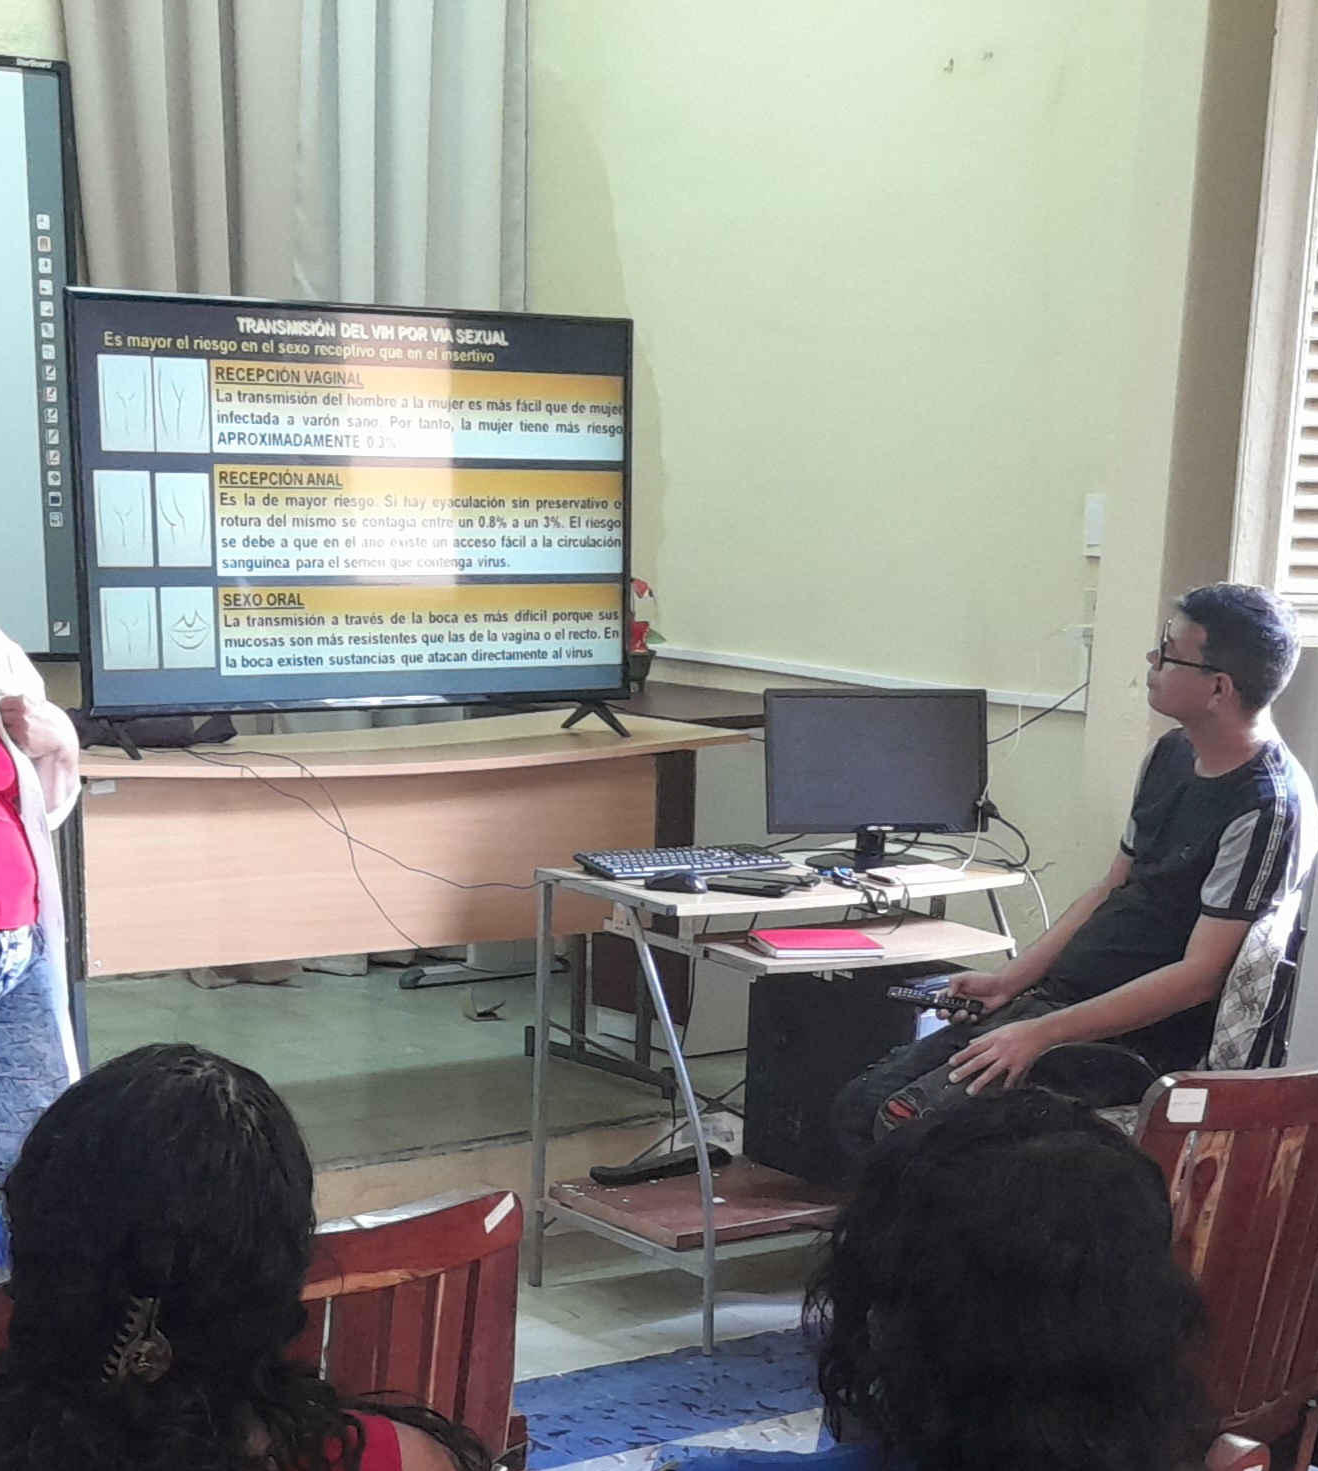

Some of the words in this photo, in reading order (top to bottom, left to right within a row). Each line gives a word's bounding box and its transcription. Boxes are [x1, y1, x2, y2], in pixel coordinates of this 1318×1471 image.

[236, 316, 336, 335] TRANSMISIÓN
[340, 322, 369, 340] DEL
[370, 324, 394, 340] VIH
[397, 325, 428, 342] POR
[456, 328, 509, 346] SEXUAL
[104, 330, 122, 347] Es
[126, 335, 172, 352] mayor
[176, 334, 189, 349] el
[193, 335, 237, 355] riesgo
[240, 340, 258, 353] en
[261, 338, 274, 353] el
[278, 342, 310, 355] sexo
[214, 366, 300, 384] RECEPCIÓN
[304, 370, 363, 387] VAGINAL
[215, 388, 232, 403] La
[236, 392, 317, 405] transmisión
[322, 392, 342, 406] del
[428, 399, 464, 414] mujer
[468, 399, 482, 411] es
[486, 398, 512, 412] más
[516, 398, 541, 413] fácil
[544, 403, 567, 416] que
[571, 401, 586, 414] de
[589, 405, 624, 419] mujer
[215, 410, 279, 425] infectada
[302, 415, 339, 427] varón
[460, 417, 471, 431] la
[478, 421, 512, 436] mujer
[519, 420, 549, 433] tiene
[555, 422, 580, 434] más
[586, 421, 624, 438] riesgo
[216, 431, 359, 448] APROXIMADAMENTE
[218, 469, 303, 486] RECEPCIÓN
[306, 472, 343, 487] ANAL
[219, 491, 236, 506] Es
[244, 492, 255, 506] la
[262, 492, 278, 506] de
[285, 496, 326, 510] mayor
[511, 495, 529, 509] sin
[536, 497, 608, 512] preservativo
[220, 515, 261, 527] rotura
[266, 513, 286, 527] del
[292, 514, 336, 528] mismo
[458, 518, 473, 528] un
[478, 515, 507, 528] 0.8%
[523, 518, 538, 528] un
[543, 515, 564, 528] 3%.
[569, 515, 581, 529] El
[585, 516, 622, 532] riesgo
[220, 537, 236, 548] se
[242, 534, 274, 548] debe
[293, 538, 318, 551] que
[323, 538, 339, 548] en
[453, 538, 496, 548] acceso
[500, 534, 526, 548] fácil
[542, 534, 552, 548] la
[556, 534, 622, 548] circulación
[221, 555, 290, 572] sanguínea
[296, 558, 324, 571] para
[328, 555, 339, 568] el
[222, 593, 262, 607] SEXO
[266, 592, 304, 606] ORAL
[223, 614, 240, 628] La
[246, 613, 325, 627] transmisión
[344, 611, 384, 626] través
[390, 611, 405, 624] de
[411, 611, 422, 624] la
[428, 611, 458, 624] boca
[464, 613, 478, 623] es
[483, 609, 508, 623] más
[552, 610, 593, 625] porque
[598, 610, 619, 621] sus
[224, 637, 284, 648] mucosas
[289, 636, 313, 646] son
[316, 633, 344, 646] más
[348, 632, 417, 645] resistentes
[421, 633, 444, 646] que
[448, 630, 465, 643] las
[468, 629, 484, 643] de
[487, 629, 497, 642] la
[501, 628, 540, 645] vagina
[554, 627, 565, 641] el
[568, 628, 600, 640] recto.
[604, 626, 619, 639] En
[225, 655, 237, 668] la
[240, 655, 273, 668] boca
[277, 655, 323, 667] existen
[328, 654, 395, 666] sustancias
[400, 653, 423, 666] que
[427, 651, 467, 663] atacan
[471, 648, 548, 662] directamente
[552, 646, 562, 659] al
[565, 648, 593, 659] virus
